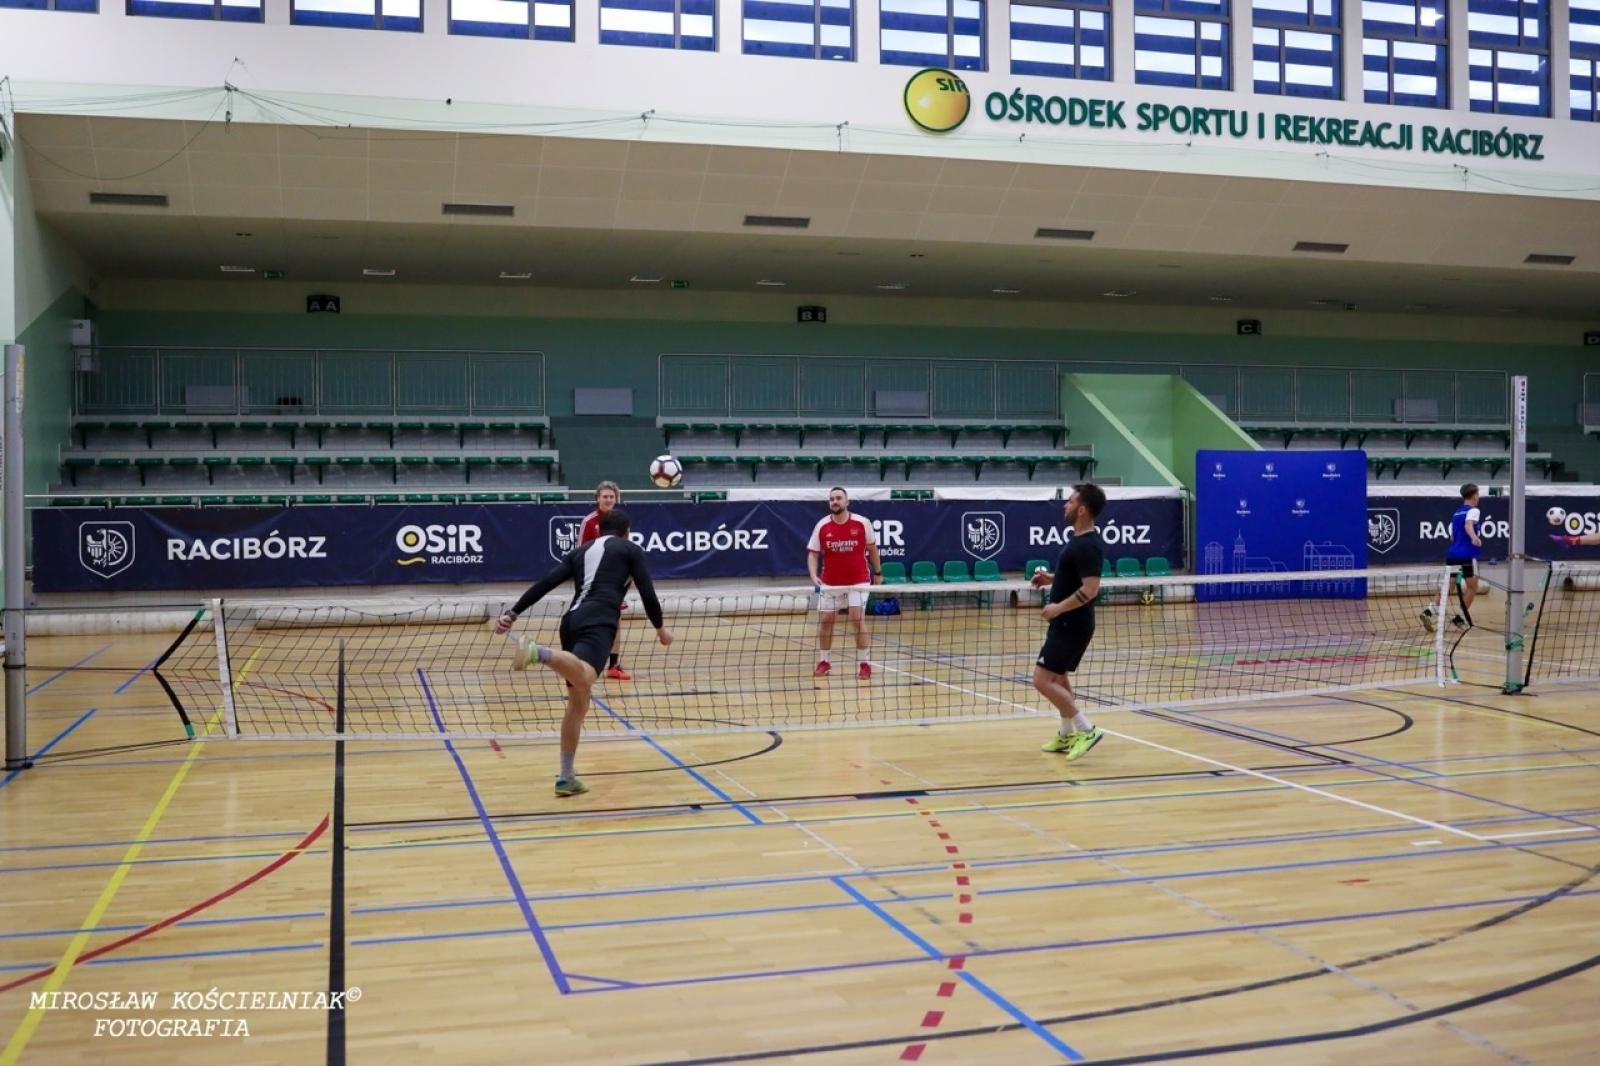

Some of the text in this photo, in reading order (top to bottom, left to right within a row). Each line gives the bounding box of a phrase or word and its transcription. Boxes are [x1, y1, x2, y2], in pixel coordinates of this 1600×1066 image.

[984, 87, 1545, 161] OŚRODEK SPORTU I REKREACJI RACIBÓRZ
[326, 300, 337, 312] A
[166, 530, 327, 561] RACIBÓRZ
[628, 523, 769, 552] RACIBÓRZ
[872, 519, 905, 546] iR
[1029, 519, 1151, 546] RACÓRZ
[431, 553, 484, 565] RACIBÓRZ
